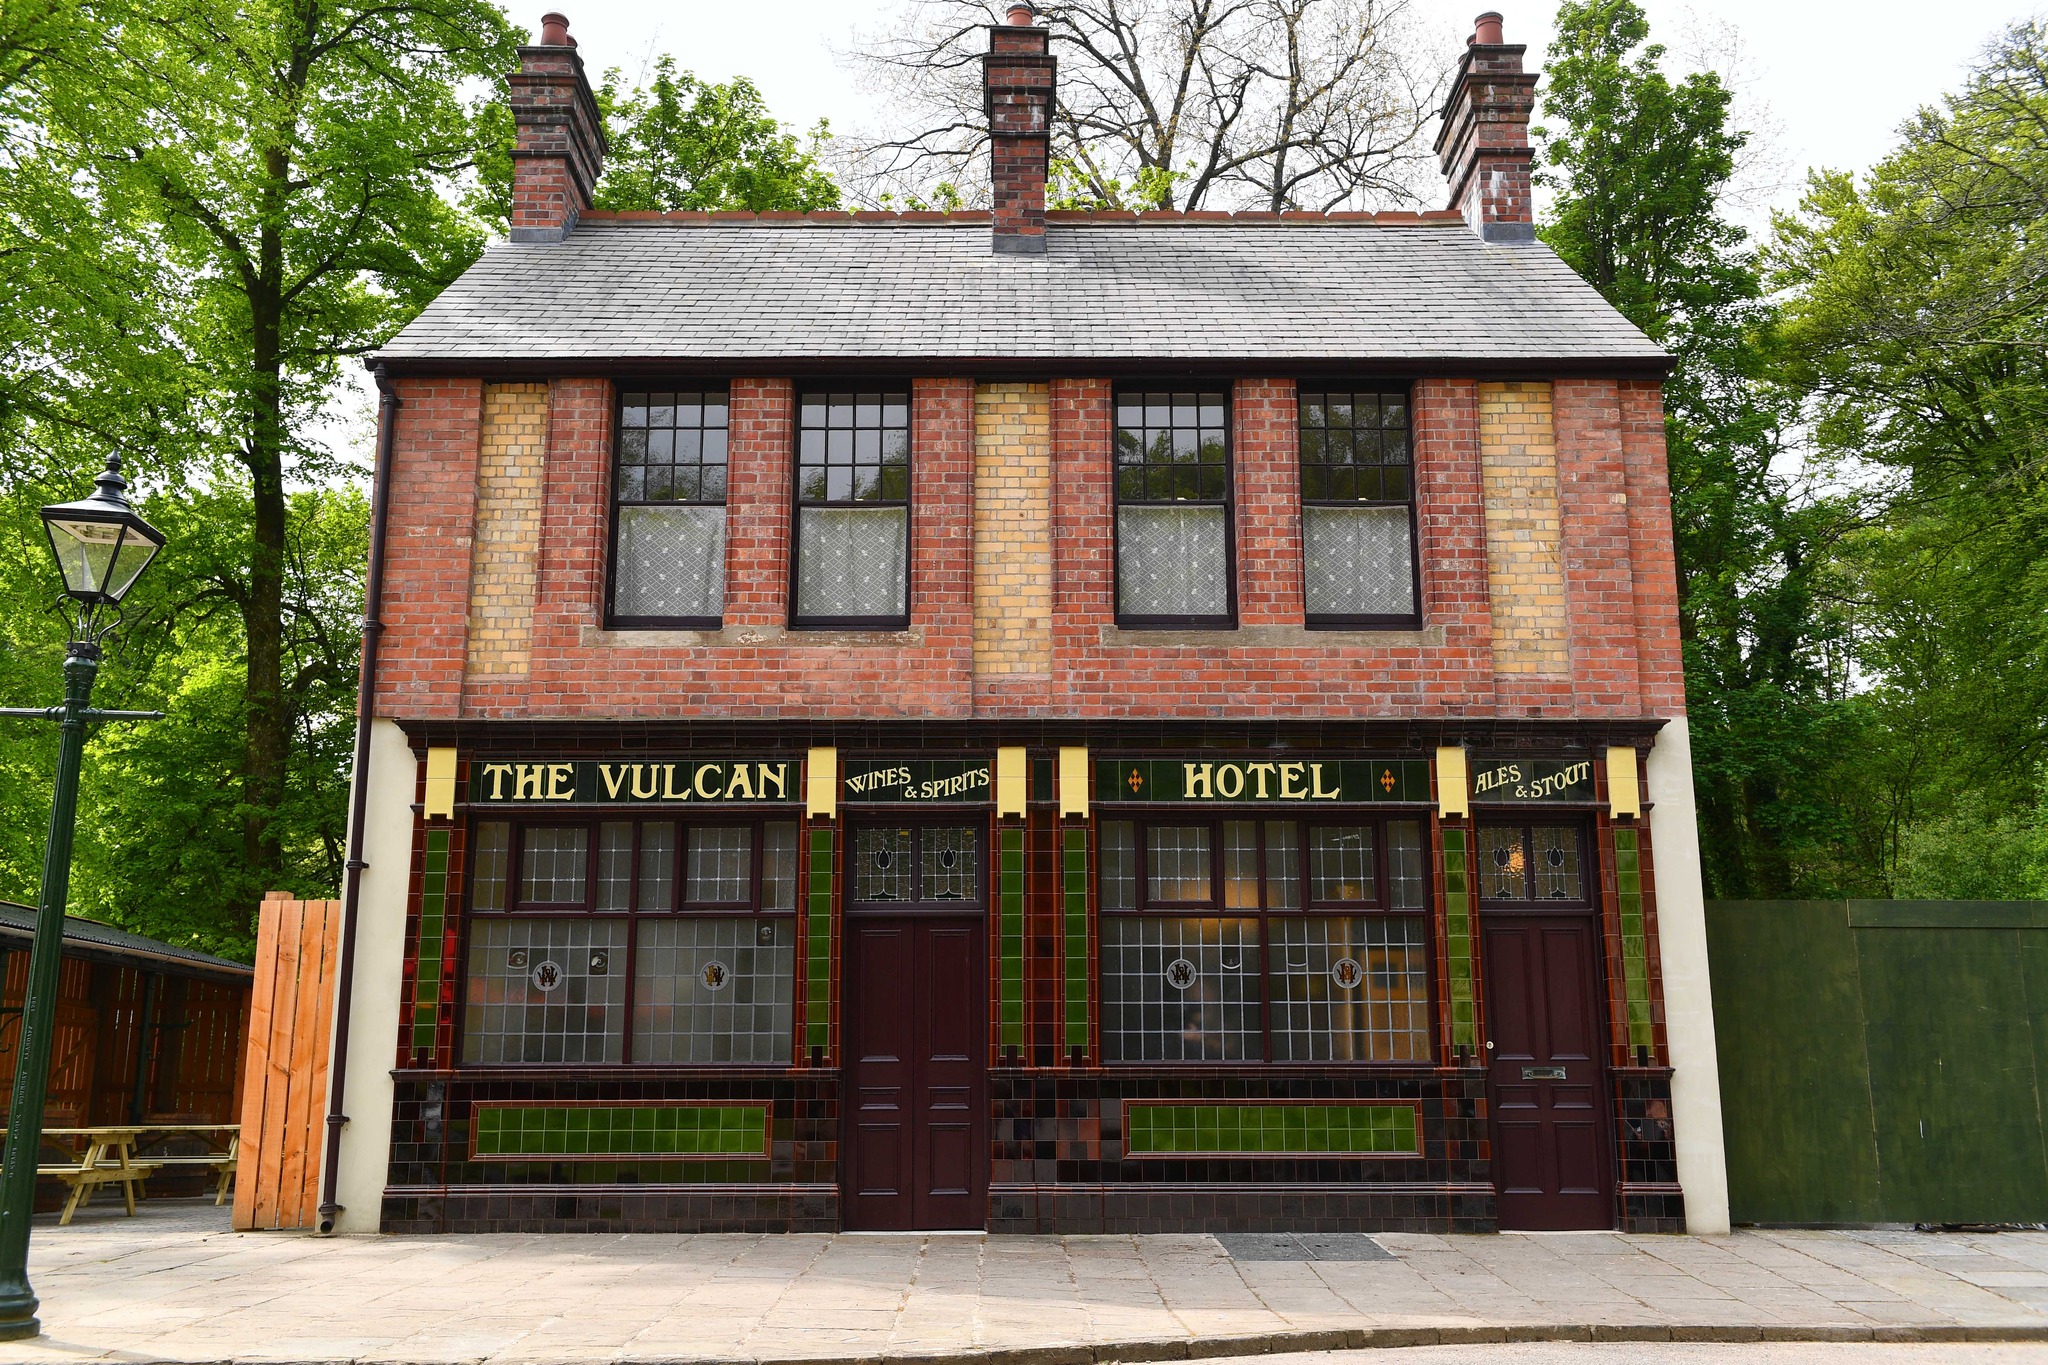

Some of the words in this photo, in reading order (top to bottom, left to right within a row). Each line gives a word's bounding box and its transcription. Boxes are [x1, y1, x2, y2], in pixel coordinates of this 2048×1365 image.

[482, 763, 576, 800] THE
[598, 762, 787, 800] VULCAN
[845, 766, 912, 794] WINES
[904, 784, 918, 799] &
[920, 767, 990, 799] SPIRITS
[1183, 761, 1341, 800] HOTEL
[1474, 764, 1522, 794] ALES
[1515, 784, 1528, 798] &
[1530, 761, 1590, 798] STOUT
